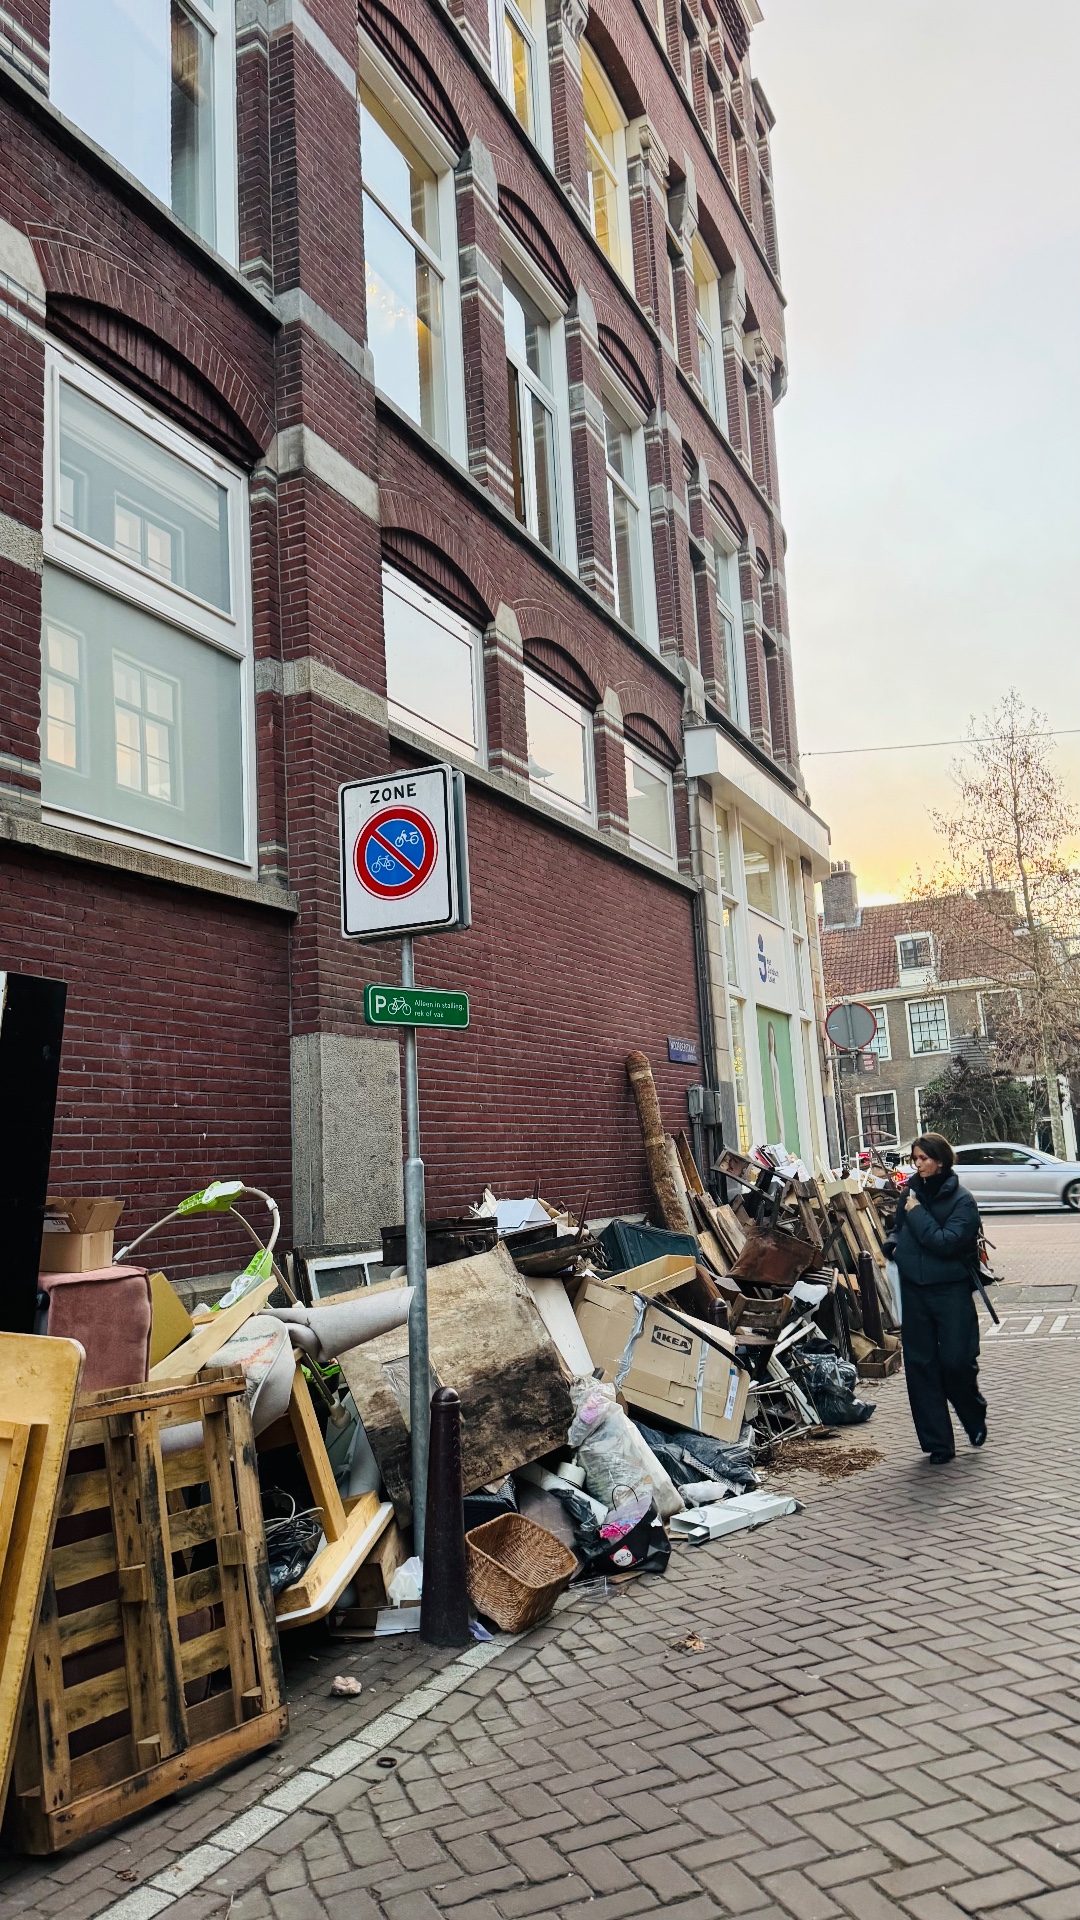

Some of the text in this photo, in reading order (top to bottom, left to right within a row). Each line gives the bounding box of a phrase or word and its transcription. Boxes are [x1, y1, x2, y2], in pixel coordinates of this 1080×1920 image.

[369, 782, 417, 804] ZONE
[375, 994, 387, 1014] P
[414, 999, 434, 1008] Alleen
[434, 1000, 441, 1008] in
[414, 1009, 425, 1017] rek
[425, 1009, 433, 1017] of
[656, 1331, 689, 1350] IKEA
